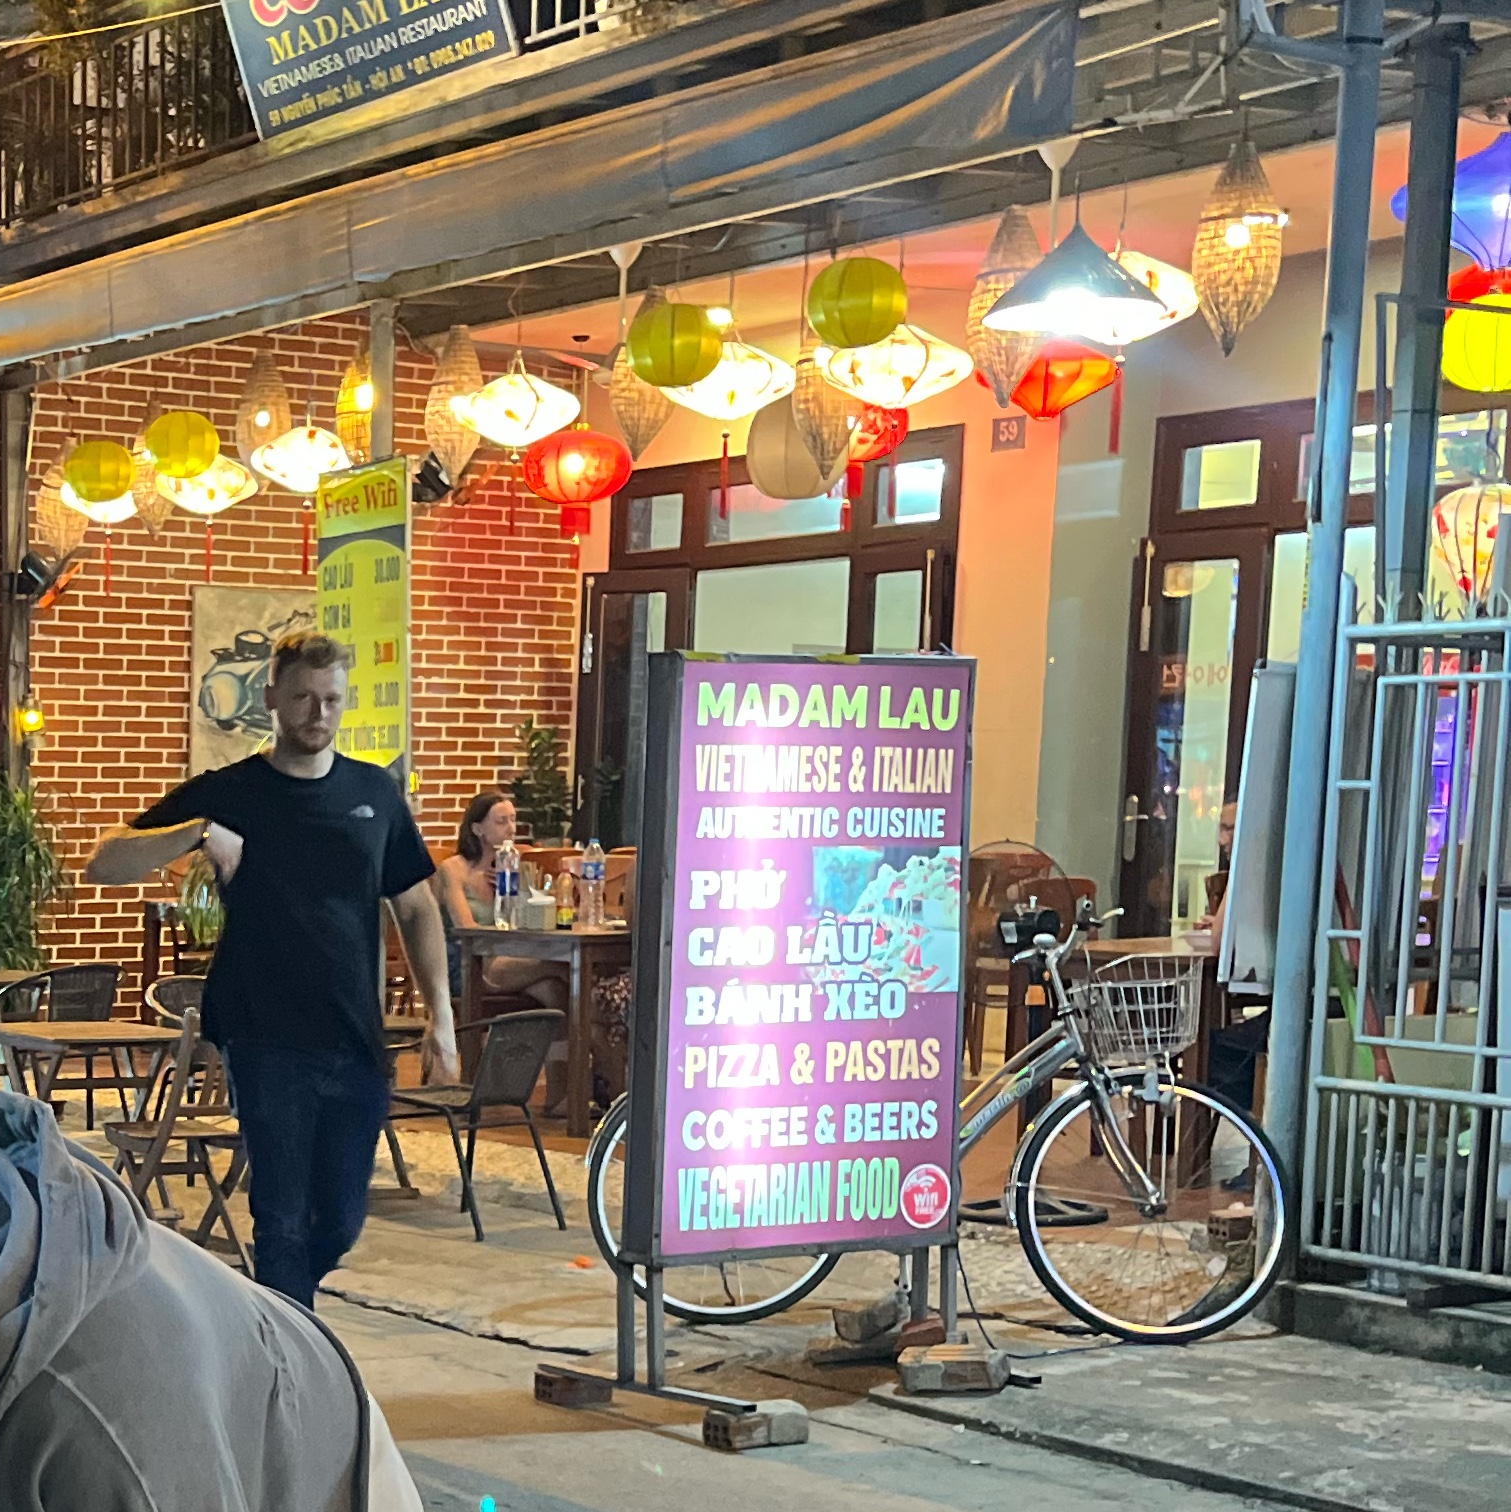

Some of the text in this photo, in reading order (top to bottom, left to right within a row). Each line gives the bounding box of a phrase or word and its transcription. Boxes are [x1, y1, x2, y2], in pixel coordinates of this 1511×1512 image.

[265, 0, 390, 65] MADAM
[345, 32, 398, 66] ITALIAN
[398, 0, 488, 46] RESTAURANT
[999, 420, 1018, 442] 59
[323, 478, 398, 520] Free Wifi
[696, 682, 961, 731] MADAM LAU
[695, 744, 954, 794] VIETNAMESE & ITALIAN
[696, 806, 946, 839] AUTHENTIC CUISINE
[689, 858, 787, 911] PHỞ
[687, 910, 874, 967] CAO LẦU
[685, 972, 908, 1026] BÁNH XÈO
[684, 1037, 941, 1089] PIZZA & PASTAS
[682, 1106, 809, 1152] COFFEE
[814, 1104, 837, 1145] &
[843, 1099, 939, 1144] BEERS
[678, 1156, 901, 1232] VEGETARIAN FOOD
